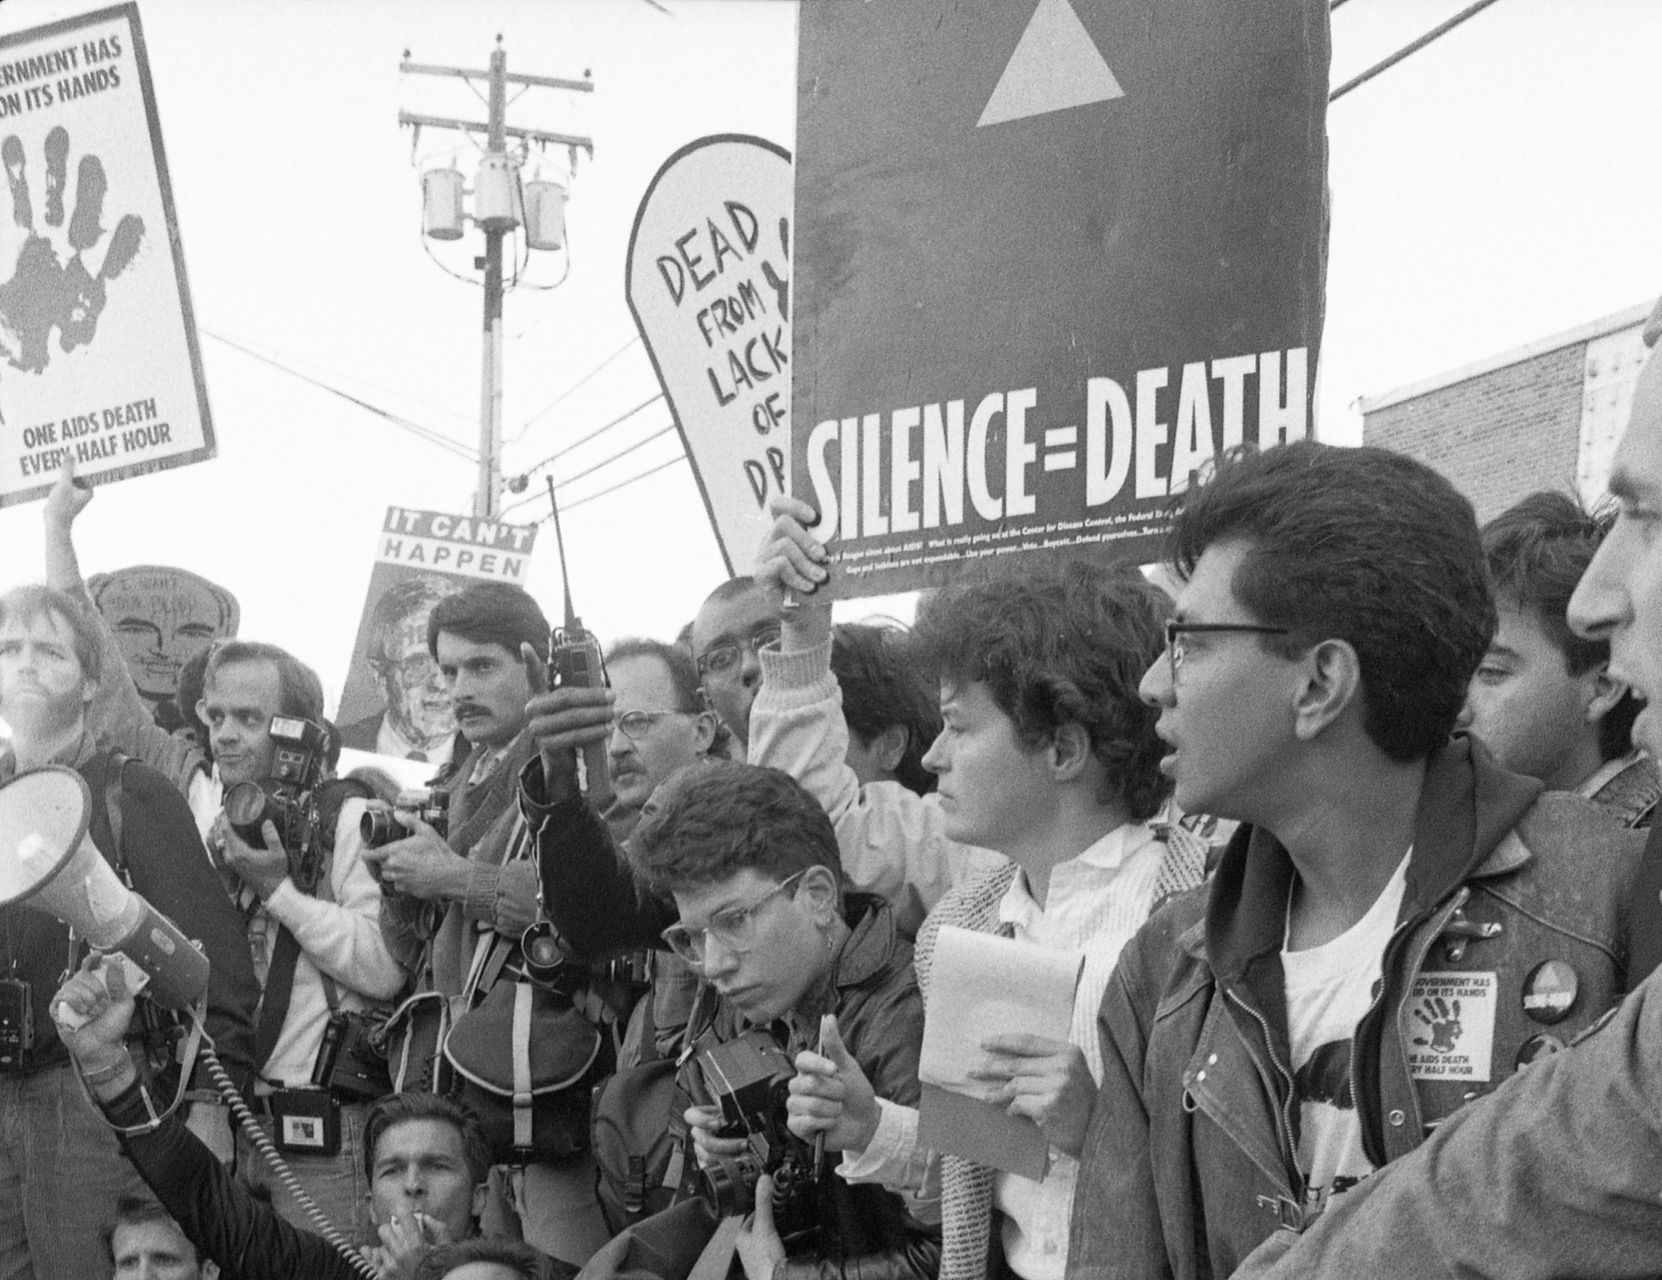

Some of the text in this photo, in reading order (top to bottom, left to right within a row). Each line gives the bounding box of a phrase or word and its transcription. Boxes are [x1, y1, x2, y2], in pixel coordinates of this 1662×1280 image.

[82, 34, 122, 65] HAS
[24, 83, 54, 111] ITS
[57, 65, 121, 102] HANDS
[656, 200, 759, 308] DEAD
[697, 278, 766, 348] FROM
[707, 325, 788, 406] LACK
[23, 397, 157, 449] ONE AIDS DEATH
[752, 392, 786, 435] OF
[76, 434, 118, 463] HALF
[122, 422, 173, 452] HOUR
[806, 347, 1308, 545] SILENCE=DEATH
[387, 508, 530, 550] IT CAN'T
[1008, 529, 1020, 538] the
[1022, 525, 1044, 536] Center
[1046, 524, 1056, 533] for
[1114, 514, 1126, 523] the
[384, 538, 522, 578] HAPPEN
